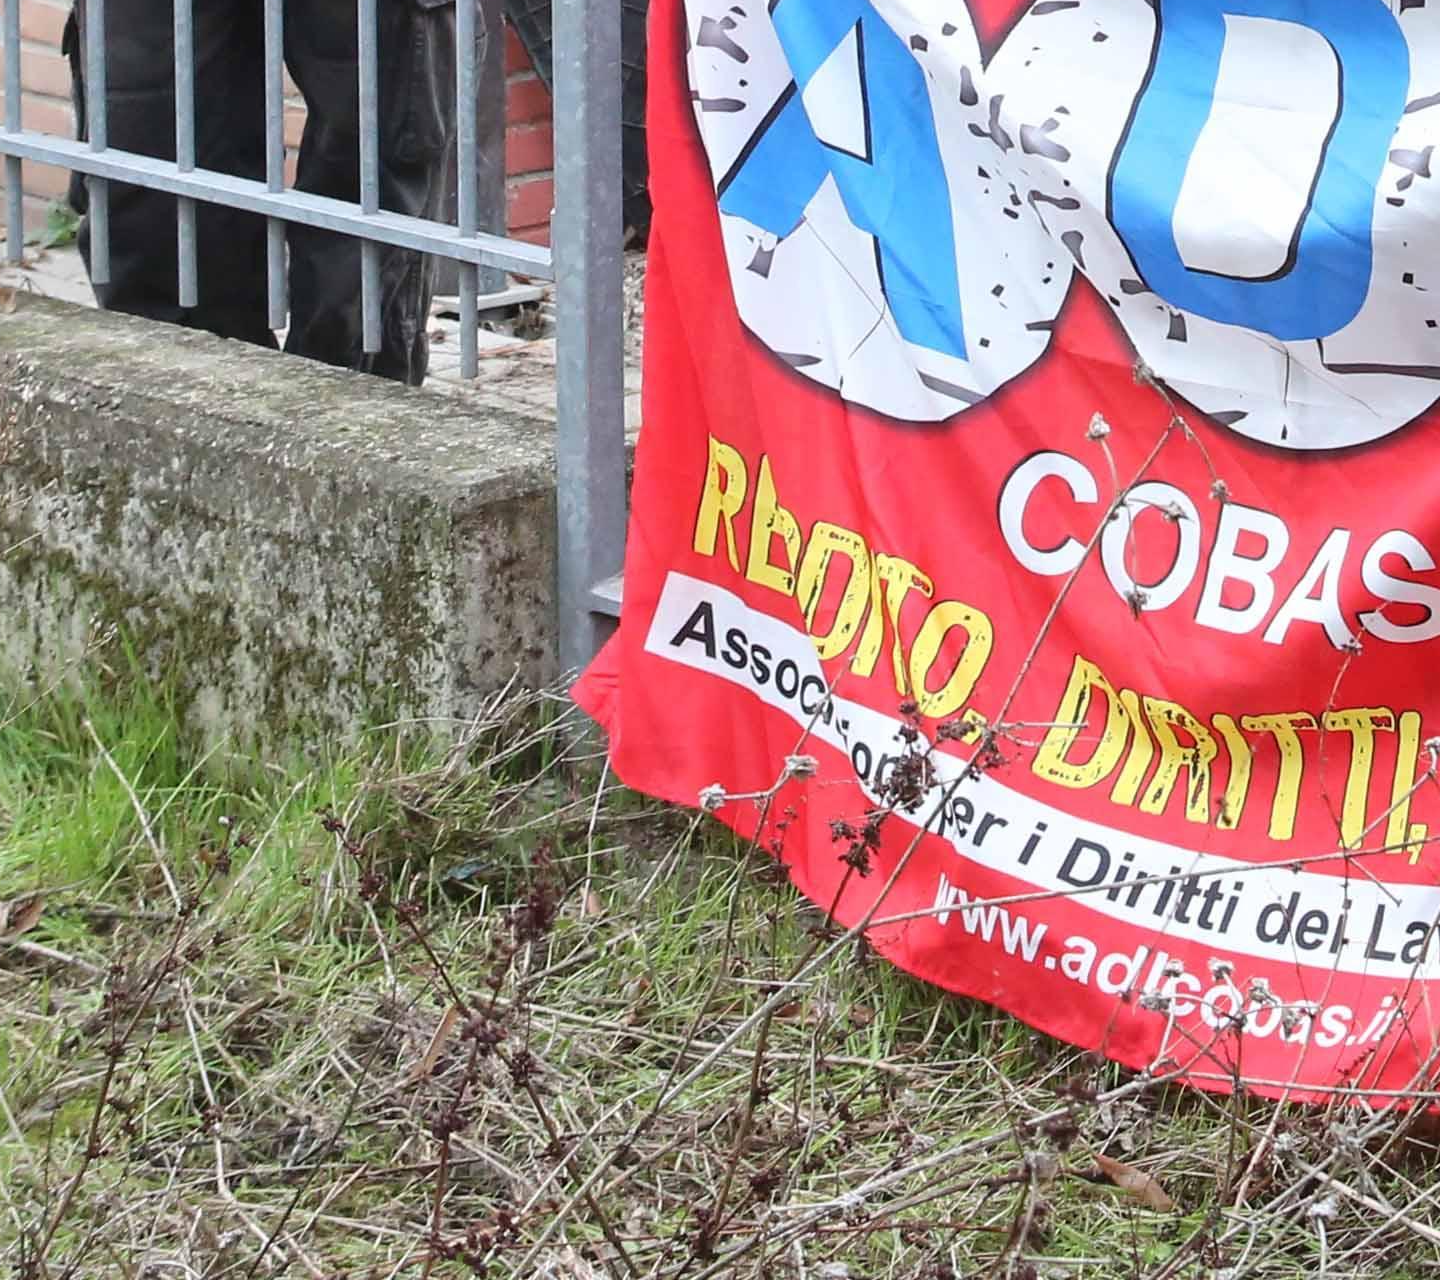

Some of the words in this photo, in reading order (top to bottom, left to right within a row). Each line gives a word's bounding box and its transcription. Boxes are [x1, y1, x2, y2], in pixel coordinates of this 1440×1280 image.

[1030, 653, 1428, 865] DIRITTI,
[1017, 822, 1049, 866] i
[1056, 837, 1245, 935] Diritti
[1256, 891, 1350, 954] dei
